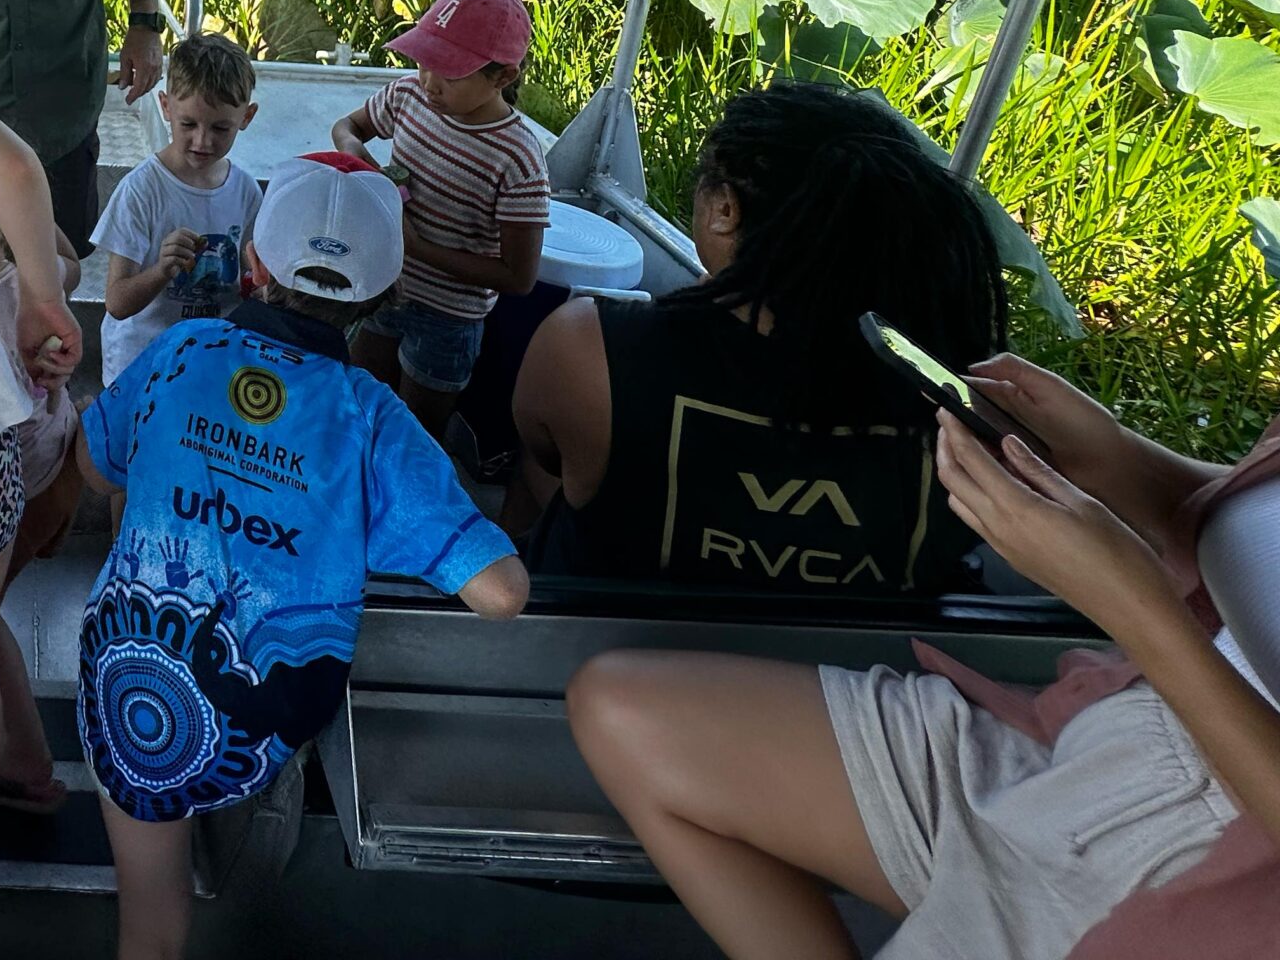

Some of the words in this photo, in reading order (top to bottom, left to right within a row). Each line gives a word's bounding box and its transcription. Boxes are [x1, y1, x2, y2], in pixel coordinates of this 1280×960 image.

[315, 239, 343, 254] Ford
[179, 437, 236, 465] ABORIGINAL
[240, 459, 308, 493] CORPORATION
[186, 413, 305, 476] IRONBARK
[173, 486, 302, 557] urbex
[701, 527, 885, 584] RVCA
